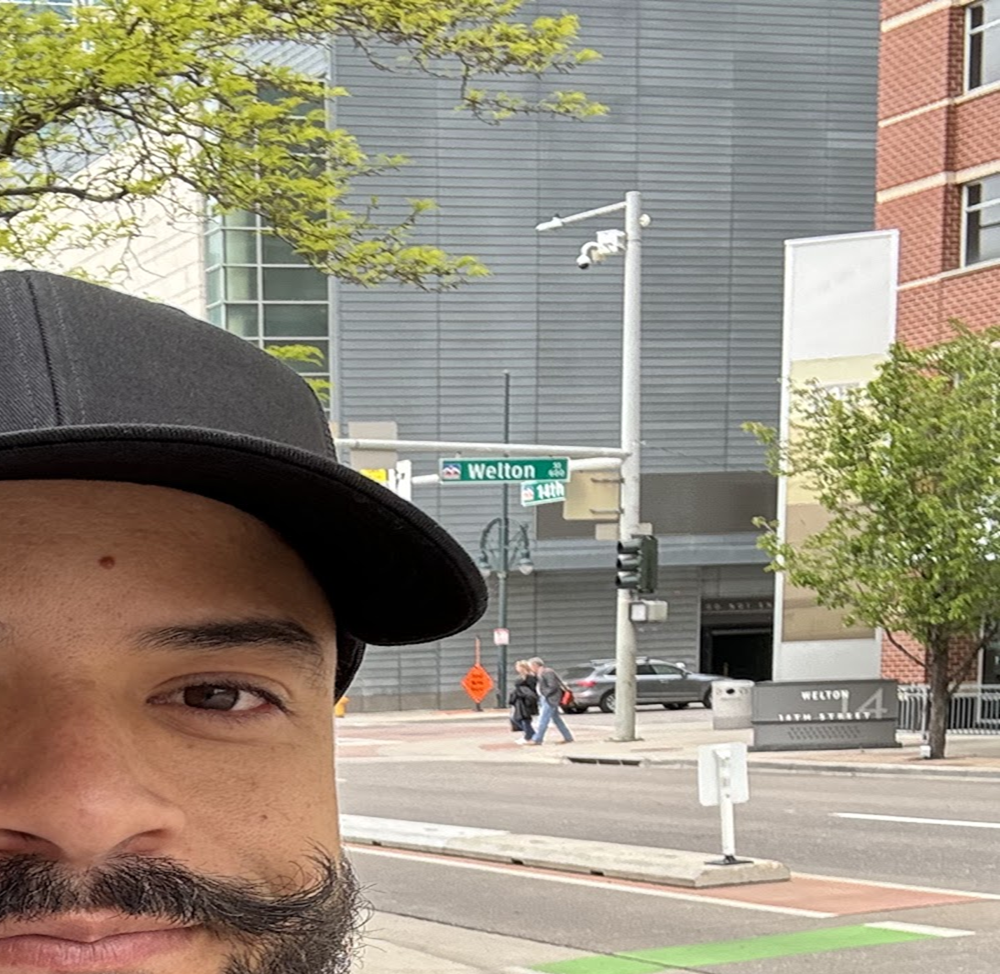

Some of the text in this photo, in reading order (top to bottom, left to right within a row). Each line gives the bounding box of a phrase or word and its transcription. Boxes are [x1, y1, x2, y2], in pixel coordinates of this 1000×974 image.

[467, 462, 535, 479] Welton
[536, 480, 565, 499] 14th
[801, 690, 849, 701] WELTON
[838, 688, 888, 719] 14
[819, 711, 871, 721] STREET
